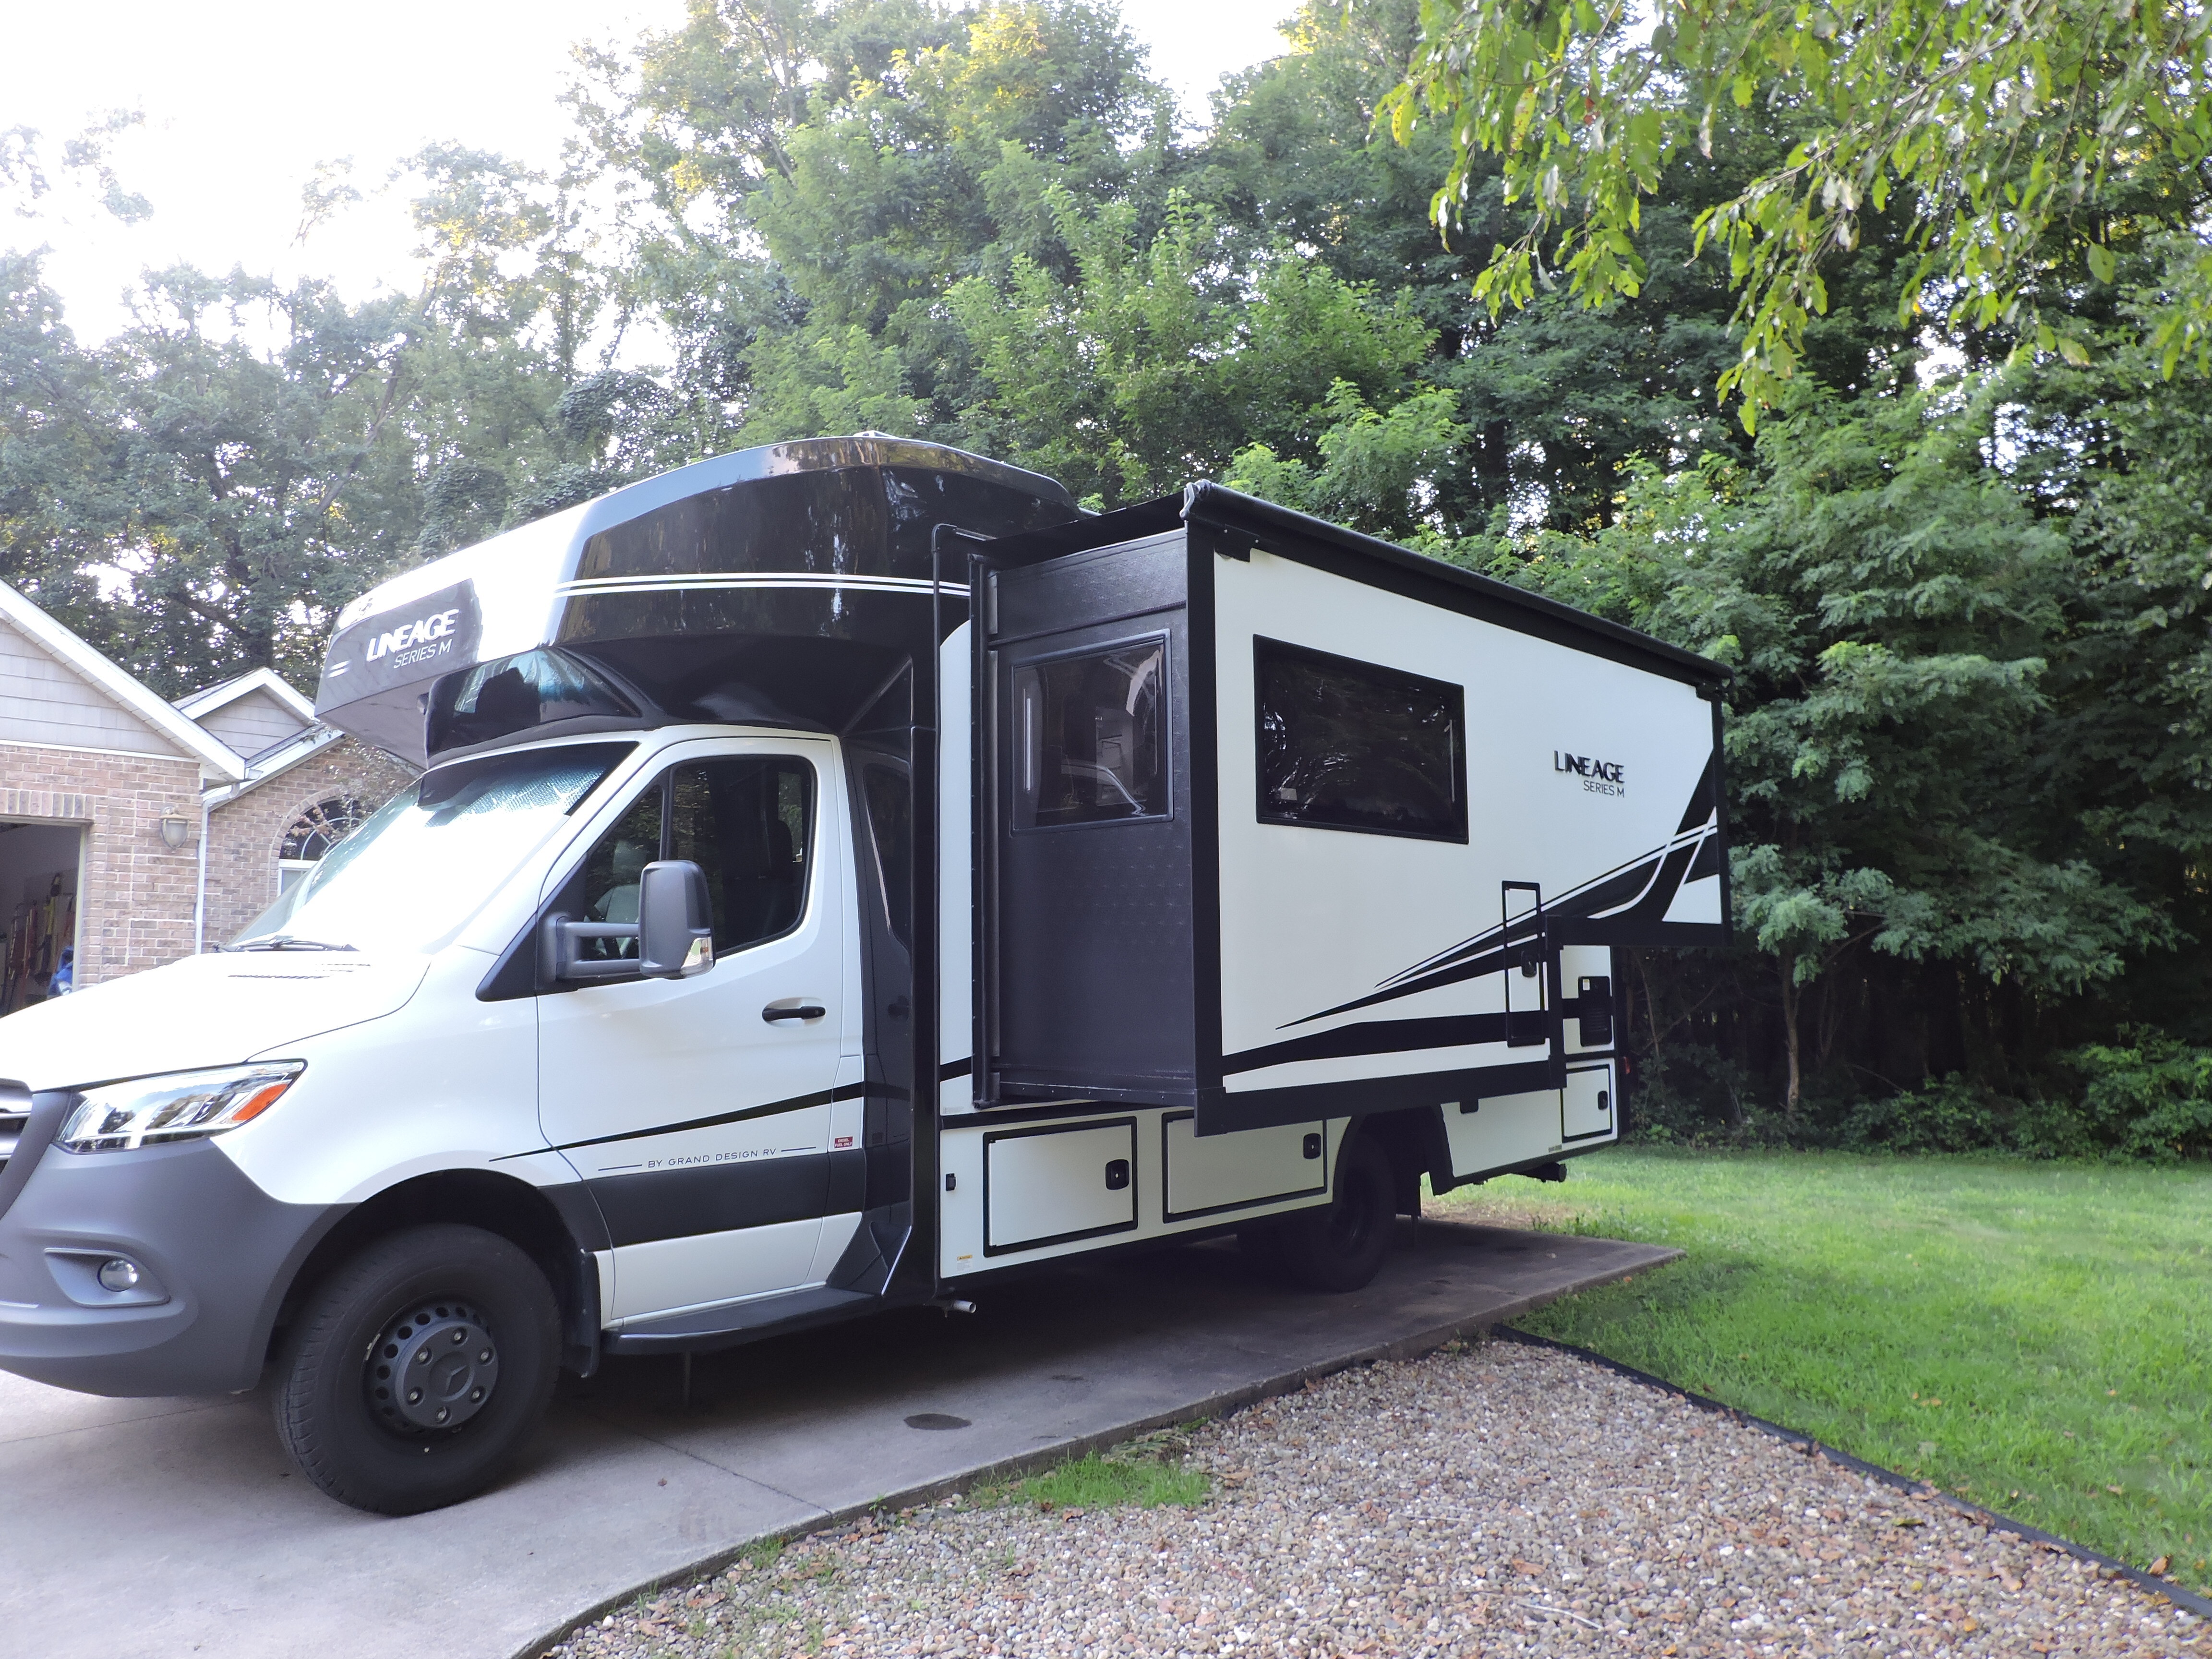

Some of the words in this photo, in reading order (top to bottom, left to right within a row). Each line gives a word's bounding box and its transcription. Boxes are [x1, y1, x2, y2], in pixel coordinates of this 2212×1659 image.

[366, 609, 459, 662] LINEAGE
[394, 643, 437, 669] SERIES
[439, 638, 453, 655] M
[1554, 750, 1625, 783] LINEAGE
[1584, 780, 1615, 795] SERIES
[1617, 786, 1625, 798] M
[648, 1160, 662, 1168] BY
[668, 1155, 710, 1166] GRAND
[716, 1150, 758, 1161] DESIGN
